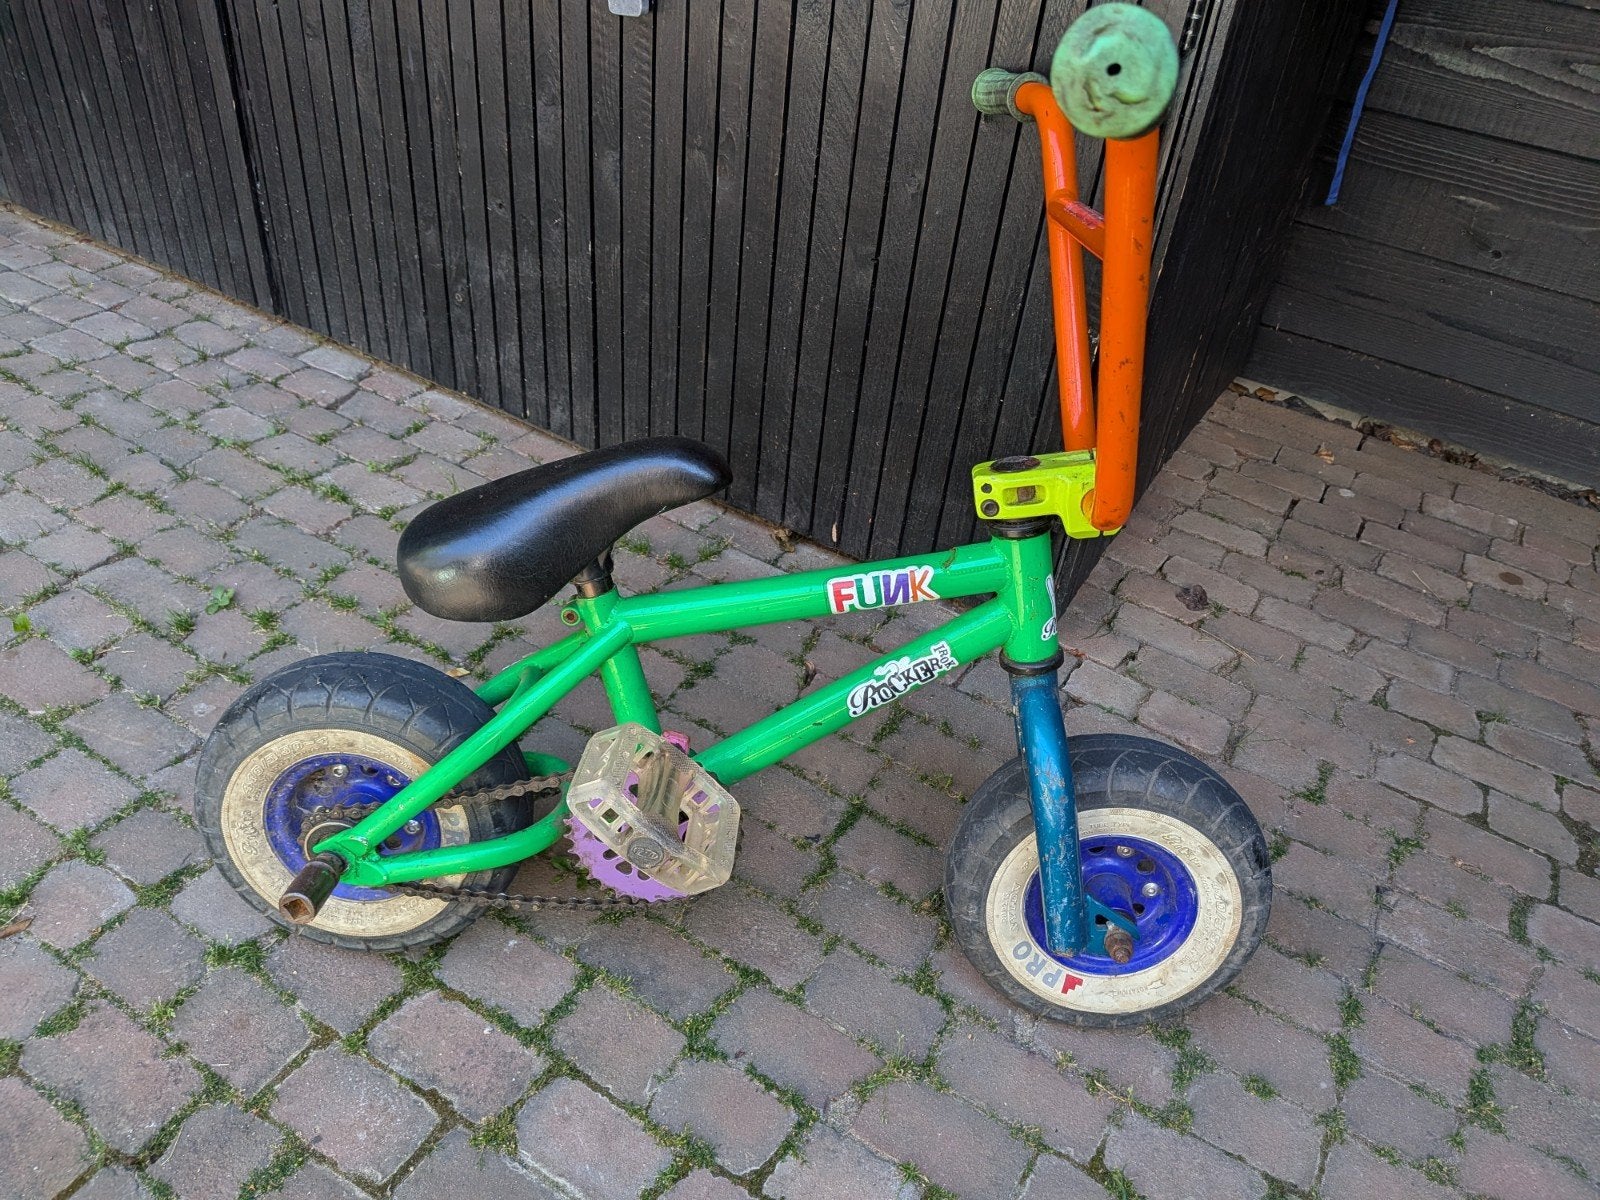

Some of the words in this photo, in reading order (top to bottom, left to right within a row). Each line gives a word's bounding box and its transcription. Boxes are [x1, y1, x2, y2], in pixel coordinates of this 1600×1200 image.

[832, 570, 936, 612] FUNK
[933, 644, 955, 669] IROK
[441, 812, 465, 845] PR
[1012, 940, 1063, 988] PRO
